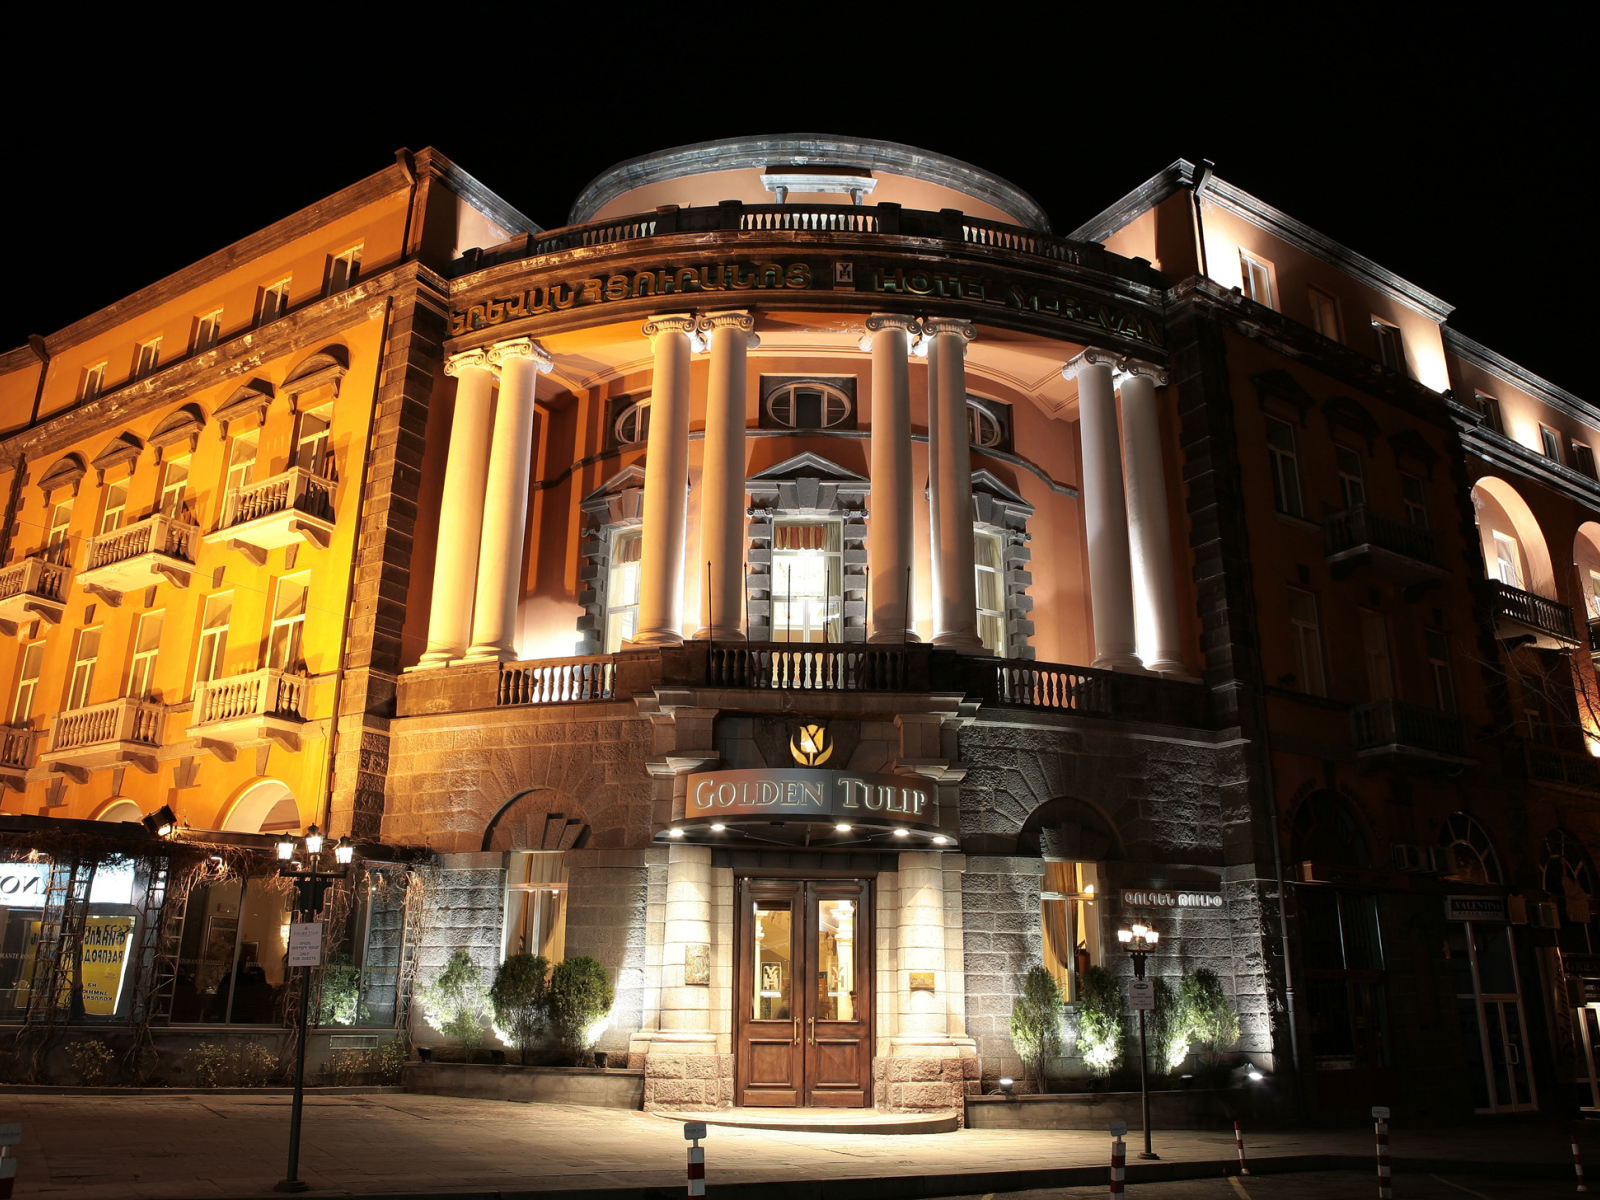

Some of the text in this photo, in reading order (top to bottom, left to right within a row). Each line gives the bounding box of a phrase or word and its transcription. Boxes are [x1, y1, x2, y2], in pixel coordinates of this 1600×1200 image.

[448, 262, 812, 337] ԵՐԵՎԱՆ ՀՅՈՒՐԱՆՈՑ
[875, 267, 1167, 348] HOTEL YEREVAN
[692, 777, 929, 816] GOLDEN TULIP
